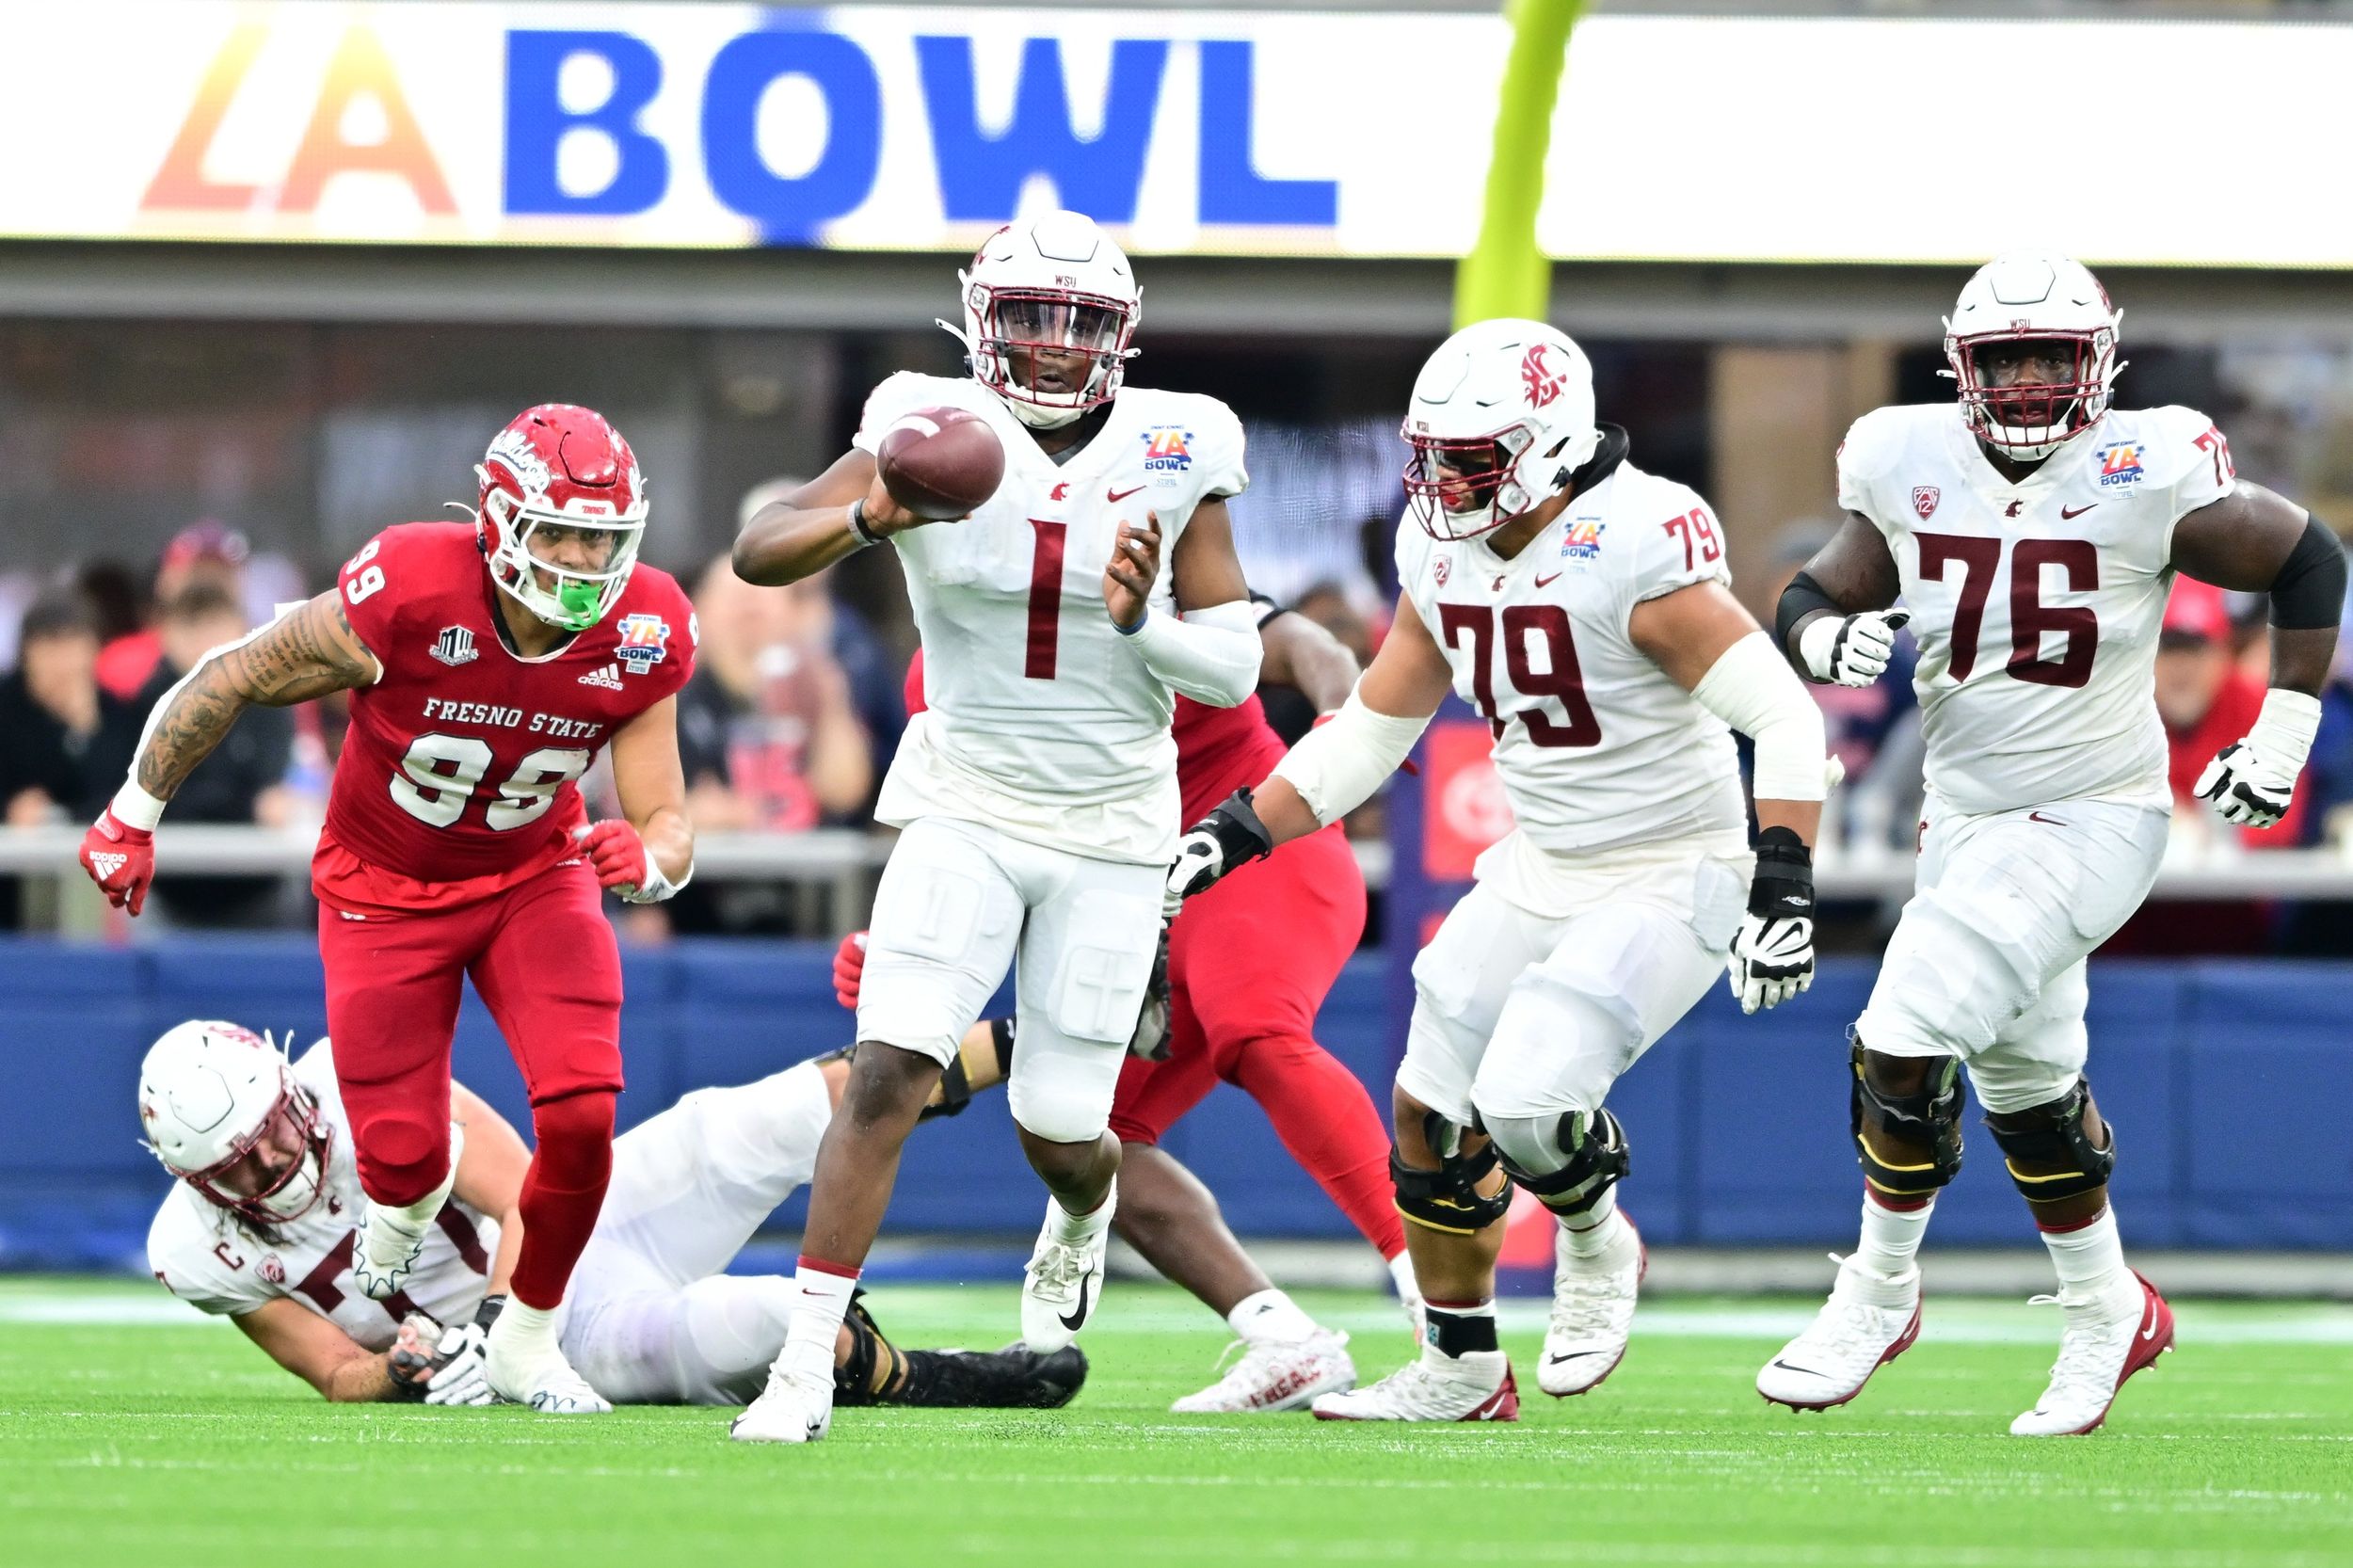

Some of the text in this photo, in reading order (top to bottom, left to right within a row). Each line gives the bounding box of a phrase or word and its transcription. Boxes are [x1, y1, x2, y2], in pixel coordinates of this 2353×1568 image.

[138, 24, 1339, 231] LA BOWL
[1055, 274, 1077, 287] WSU
[2009, 318, 2030, 329] WSU
[1146, 431, 1188, 458] LA
[1144, 459, 1189, 471] BOWL
[2102, 446, 2140, 474] LA
[2100, 472, 2141, 487] BOWL
[1918, 500, 1931, 513] 12
[1563, 521, 1599, 546] LA
[1661, 506, 1721, 572] 79
[1561, 546, 1597, 559] BOWL
[345, 539, 386, 606] 99
[1024, 519, 1068, 680] 1
[1910, 531, 2100, 689] 76
[622, 622, 661, 648] LA
[619, 648, 661, 662] BOWL
[577, 675, 624, 692] adidas
[1436, 602, 1602, 748] 79
[423, 697, 603, 739] FRESNO STATE
[388, 730, 591, 832] 99
[213, 1240, 245, 1272] C
